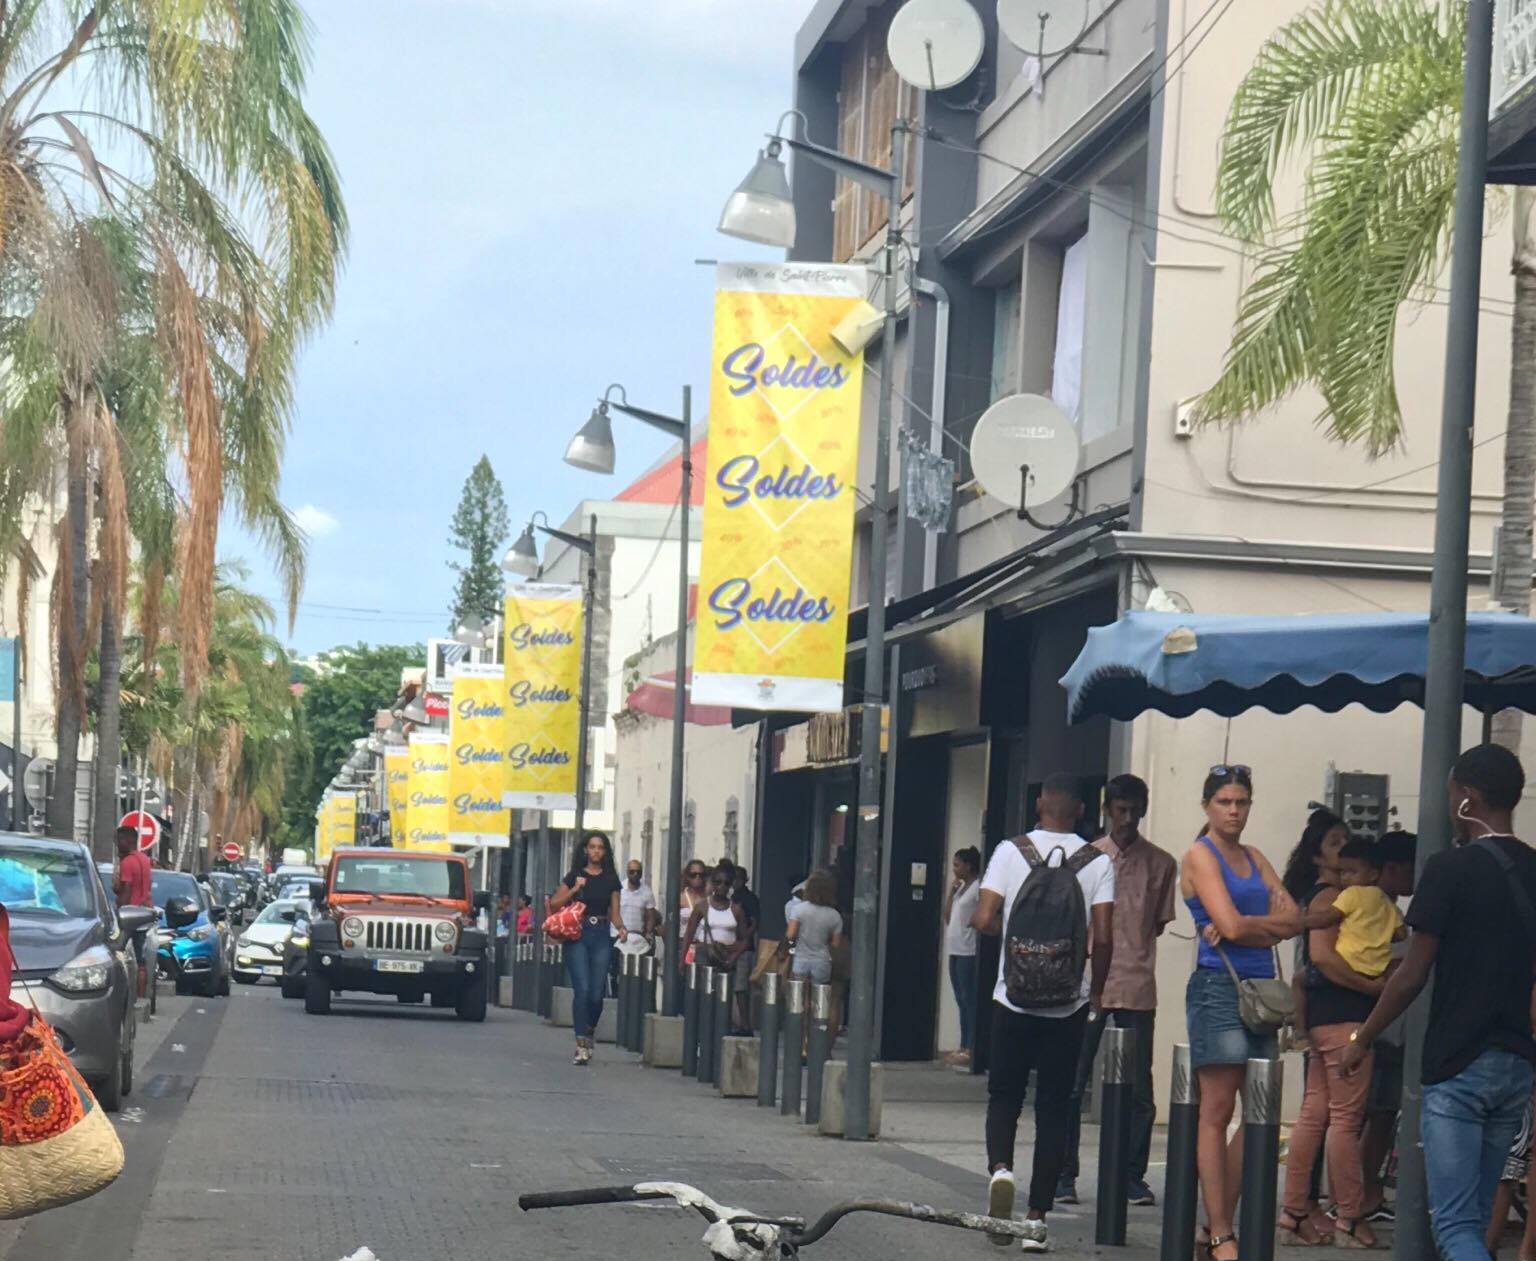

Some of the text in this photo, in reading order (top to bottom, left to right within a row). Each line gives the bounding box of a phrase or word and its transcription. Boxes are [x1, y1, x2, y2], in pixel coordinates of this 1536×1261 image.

[721, 342, 850, 397] Soldes
[715, 454, 843, 508] Soldes
[707, 577, 836, 631] Soldes
[510, 623, 573, 650] Soldes
[509, 680, 572, 707] Soldes
[457, 698, 504, 720] Solde
[508, 743, 570, 769] Soldes
